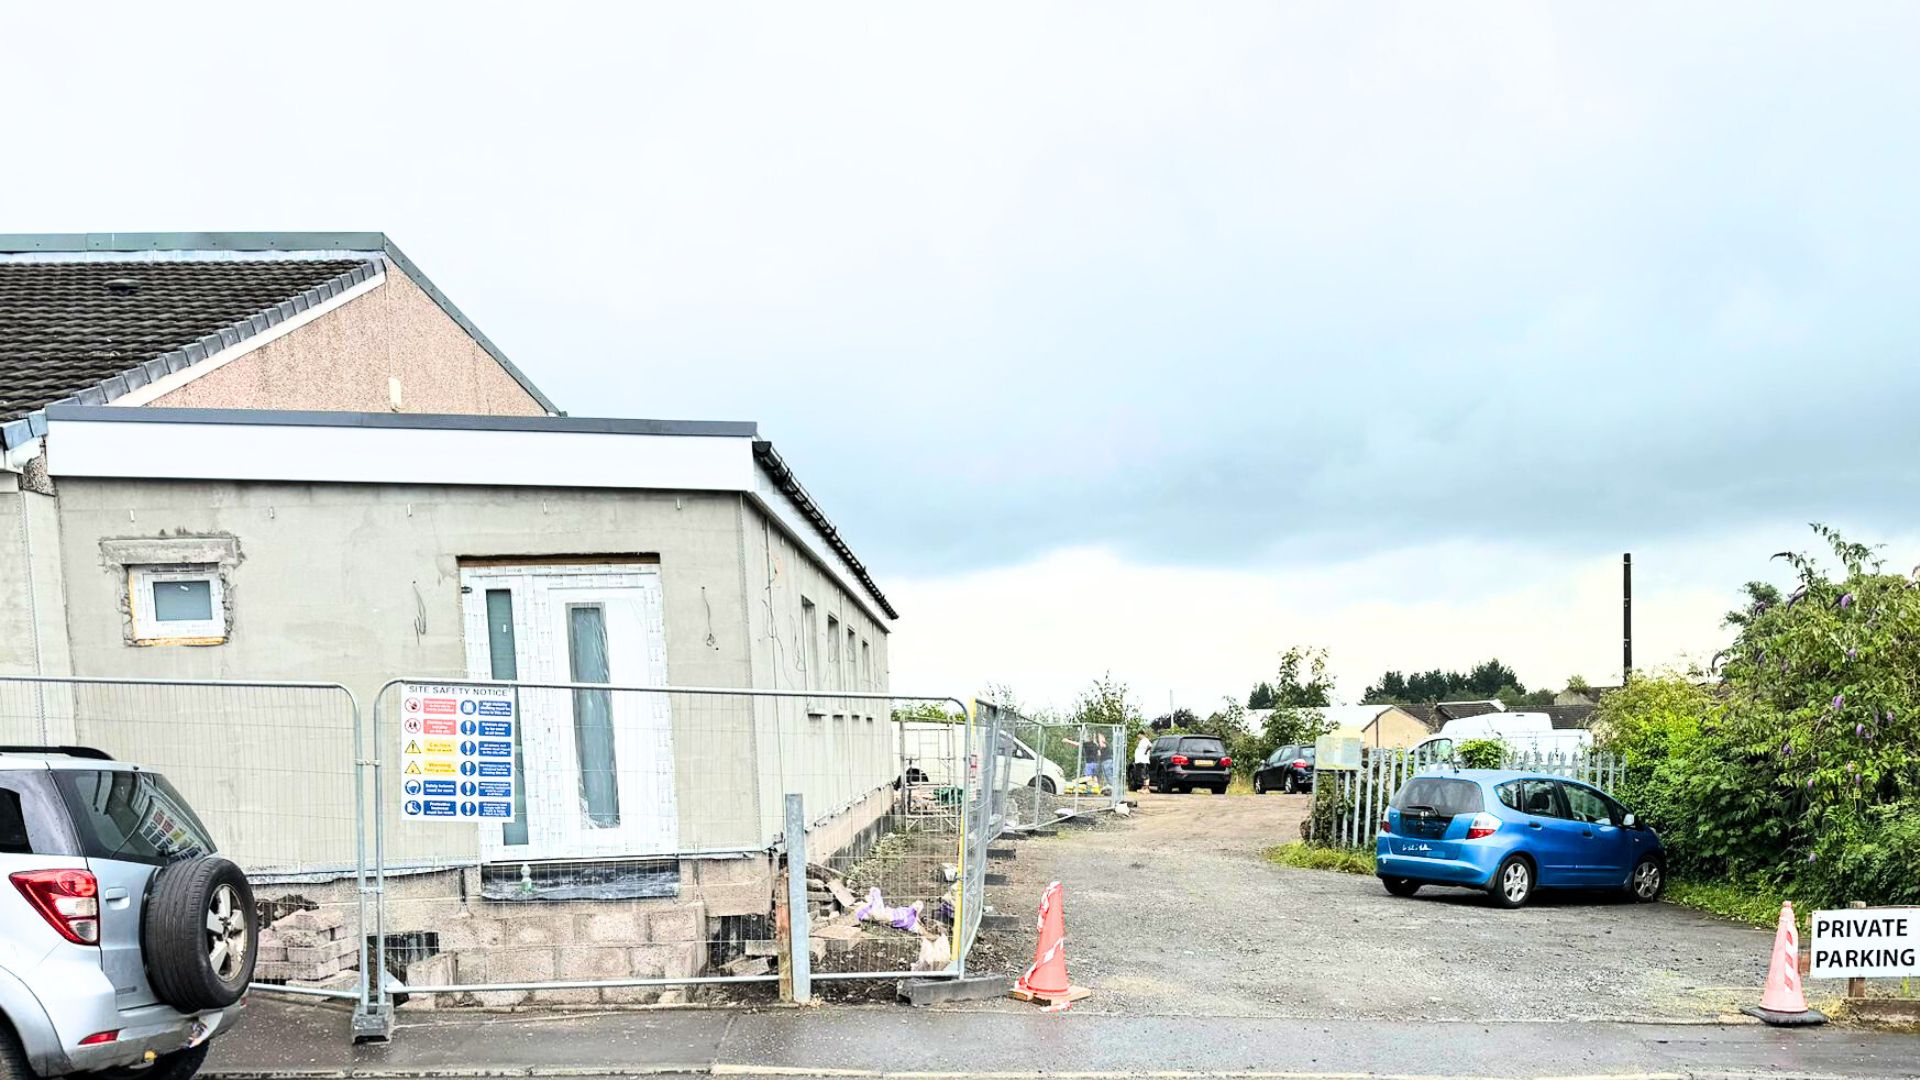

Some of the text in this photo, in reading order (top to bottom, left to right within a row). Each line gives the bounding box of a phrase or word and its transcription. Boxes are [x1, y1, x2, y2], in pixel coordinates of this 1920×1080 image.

[409, 685, 508, 697] SITE SAFETY NOTICE
[1817, 919, 1908, 938] PRIVATE
[1816, 949, 1915, 968] PARKING
